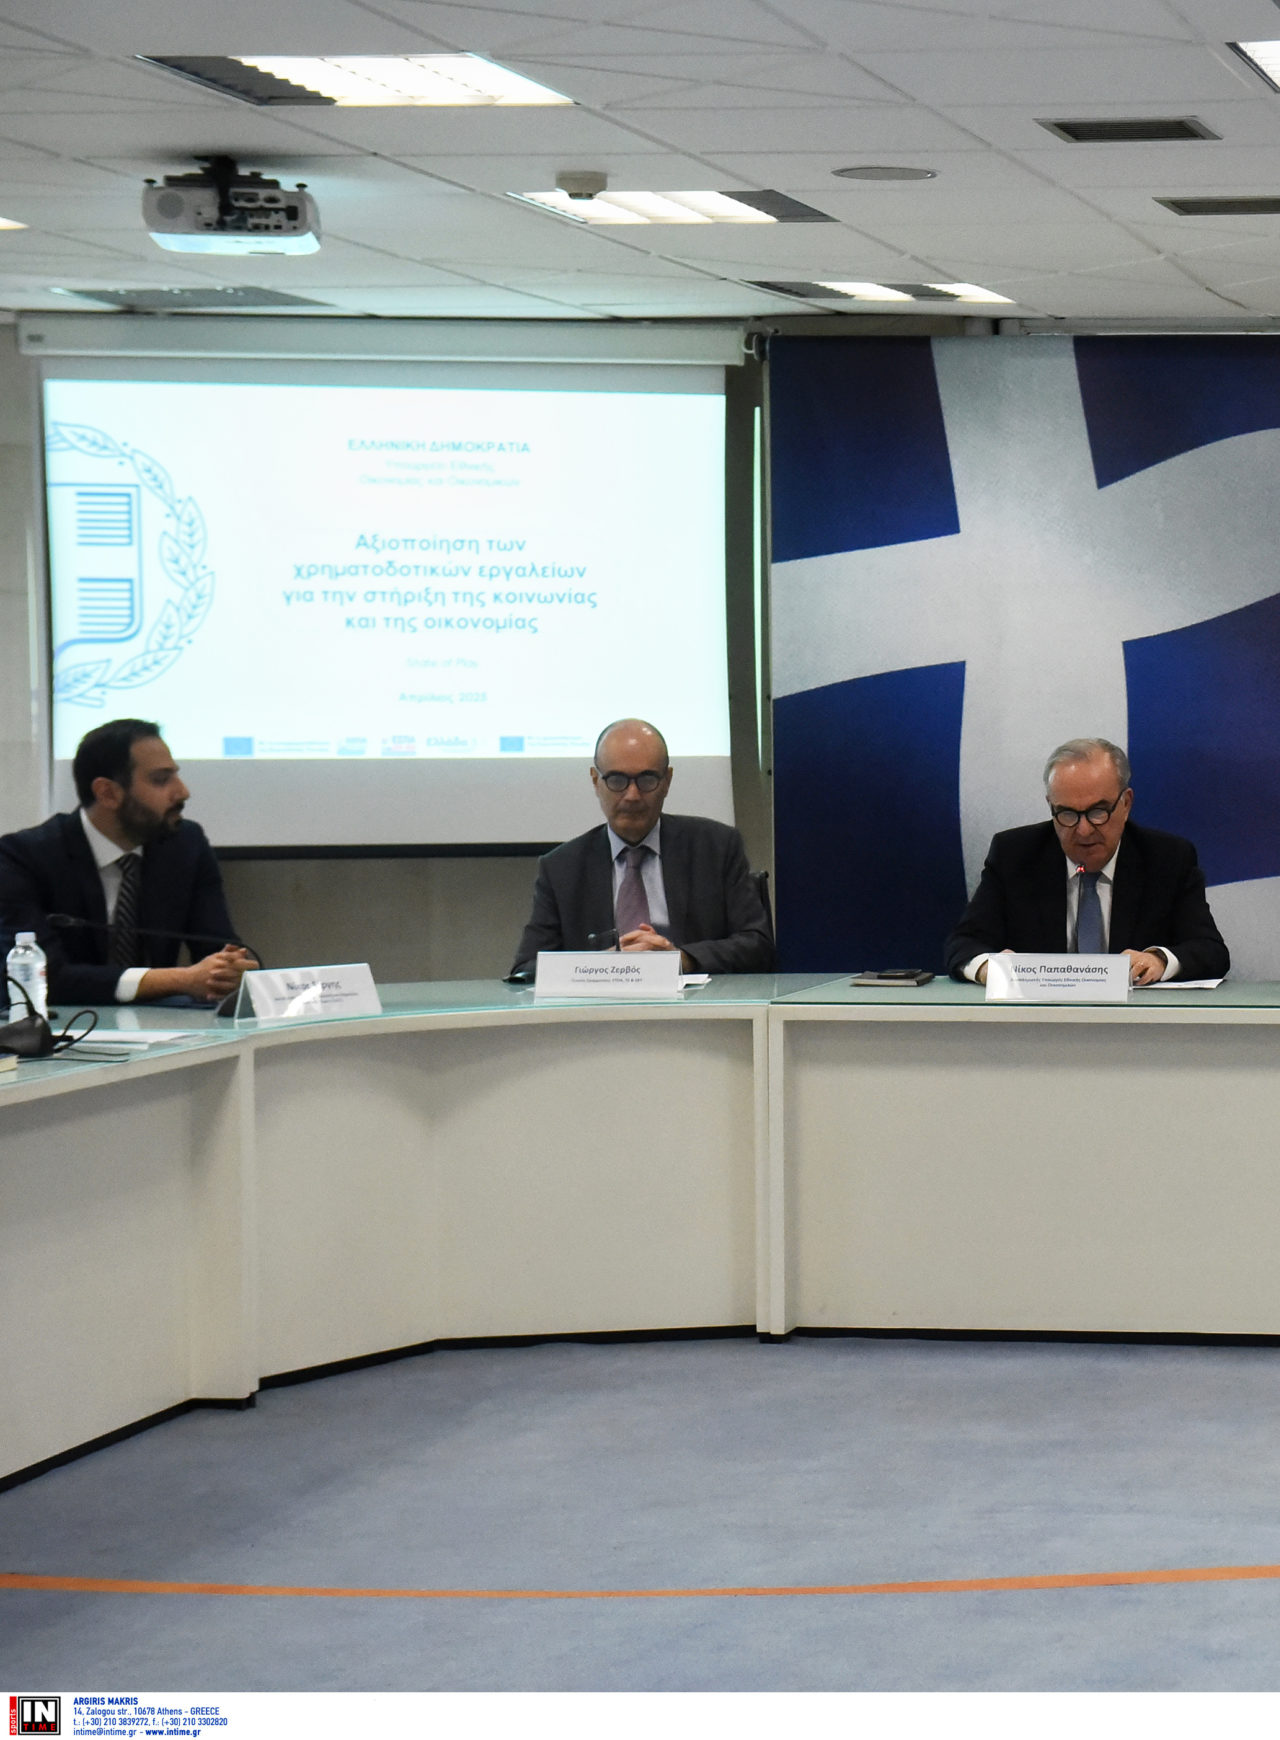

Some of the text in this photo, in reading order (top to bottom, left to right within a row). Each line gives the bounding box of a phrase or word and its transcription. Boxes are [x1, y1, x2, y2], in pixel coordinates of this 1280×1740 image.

[347, 439, 531, 453] ΕΛΛΗΝΙΚΗ ΔΗΜΟΚΡΑΤΙΑ
[355, 533, 527, 554] Αξιοποίηση των
[293, 560, 588, 581] χρηματοδοτικών εργαλείων
[281, 586, 598, 608] για την στήριξη της κοινωνίας
[344, 613, 539, 634] και της οικονομίας
[574, 965, 641, 975] Γιώργος Ζερβός
[1039, 964, 1109, 975] Παπαθανάσης
